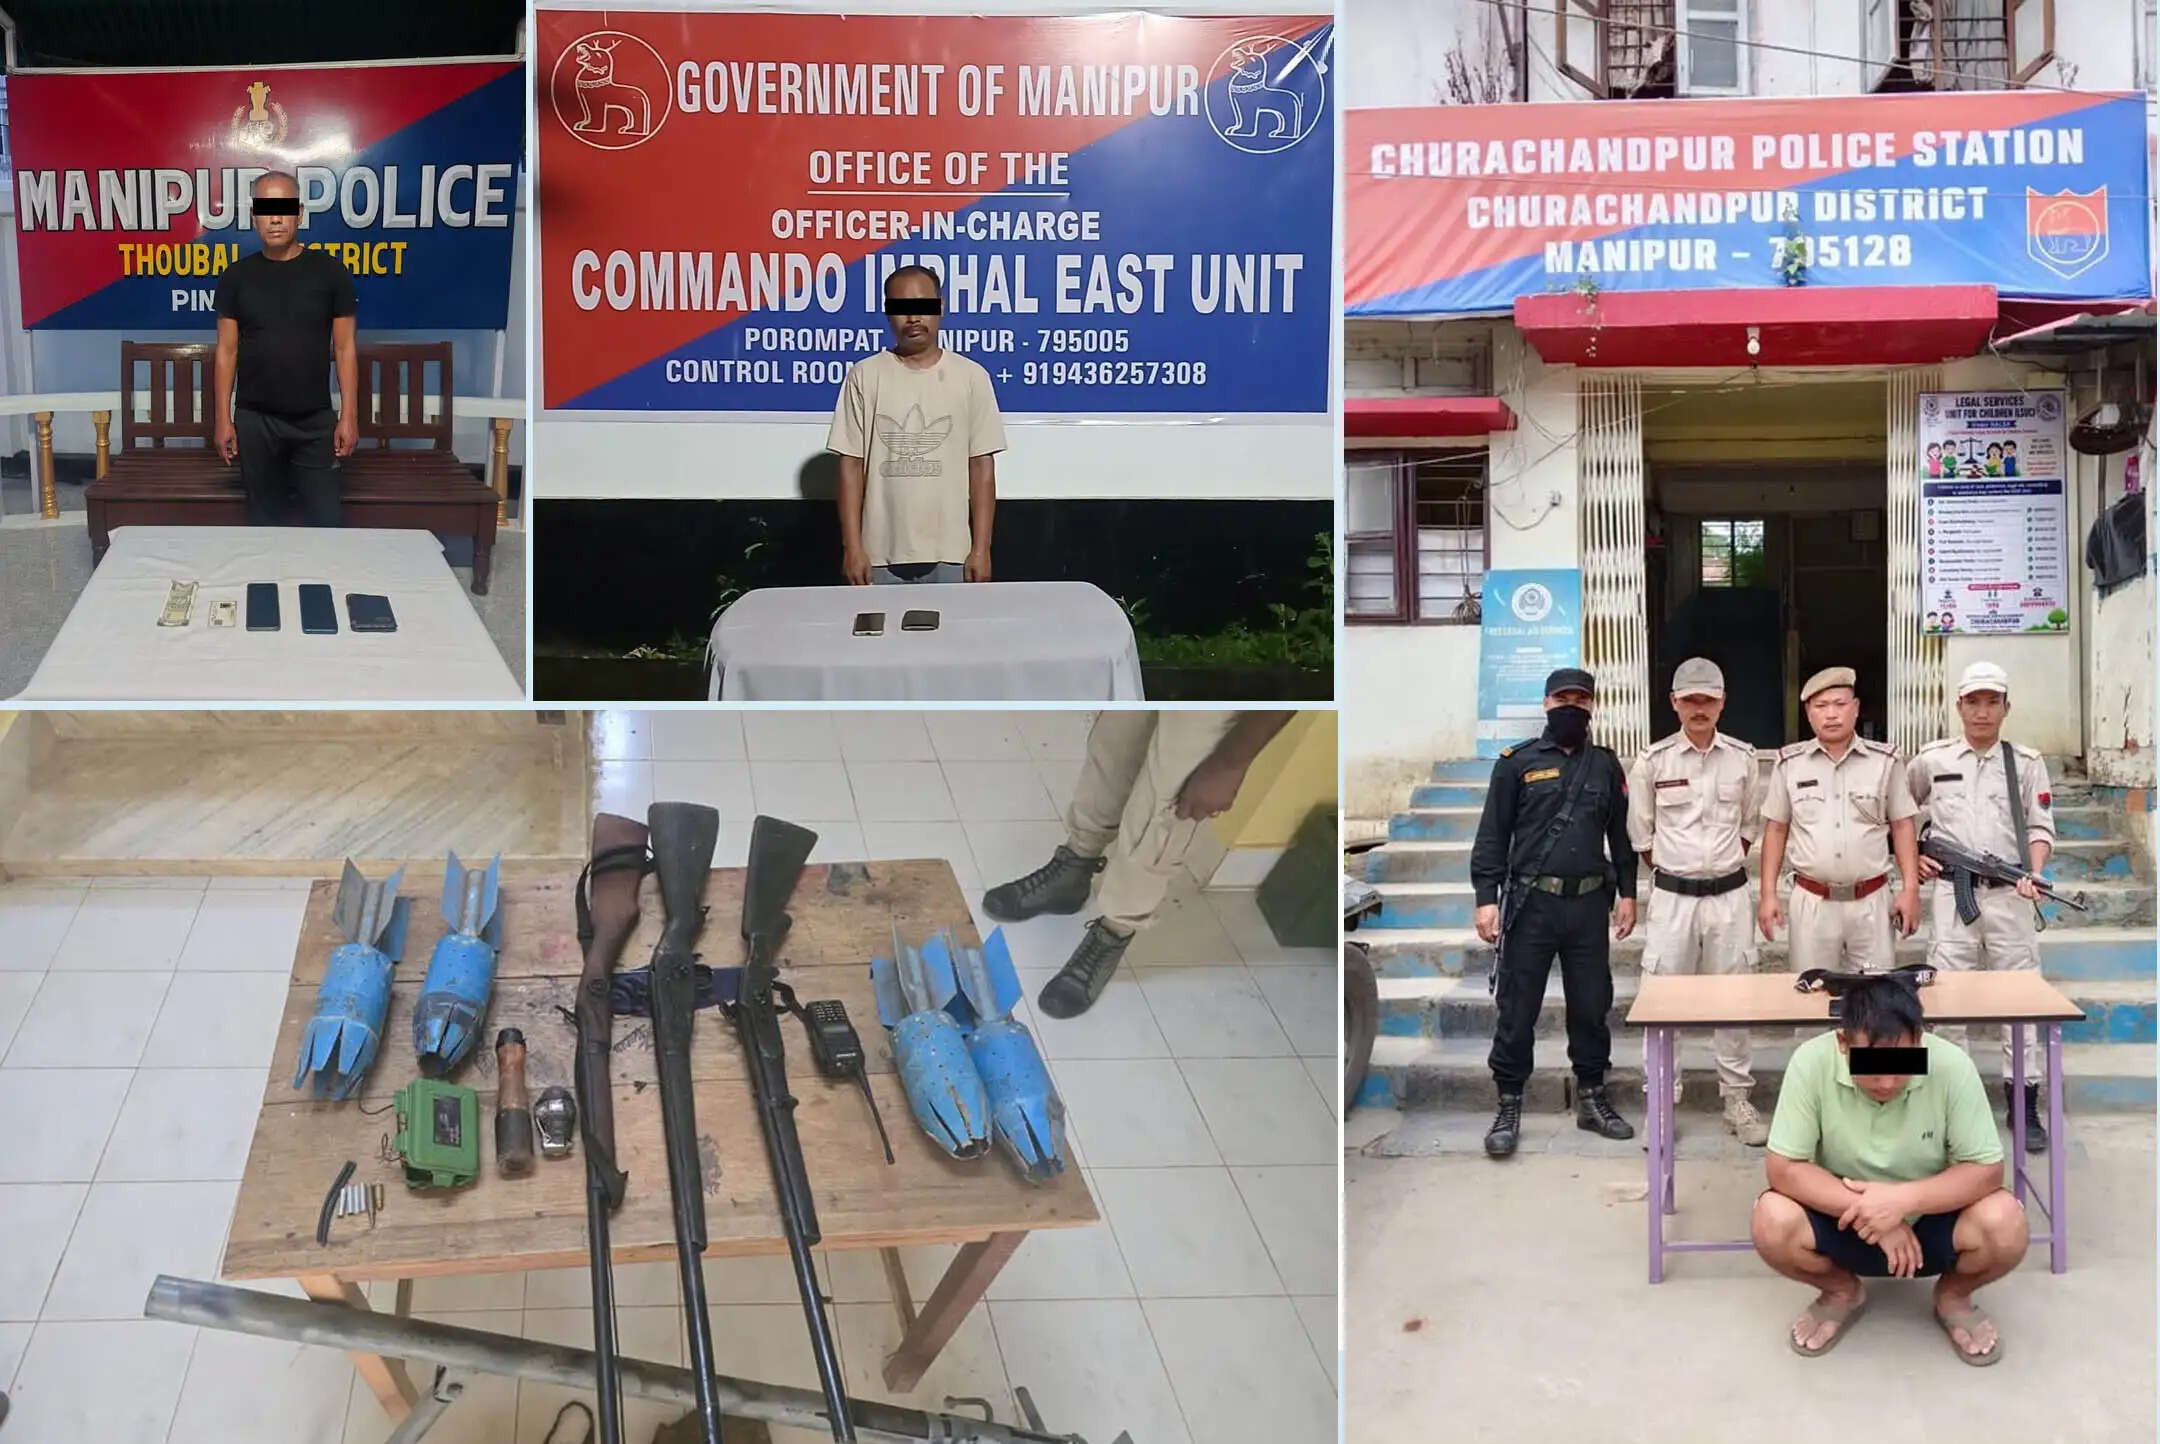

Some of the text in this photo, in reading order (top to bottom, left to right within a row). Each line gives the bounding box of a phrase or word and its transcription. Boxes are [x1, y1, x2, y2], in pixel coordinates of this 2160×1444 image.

[677, 61, 1200, 117] GOVERNMENT OF MANIPUR
[809, 151, 1069, 186] OFFICE OF THE
[1371, 127, 2084, 178] CHURACHANDPUR POLICE STATION
[296, 163, 513, 230] POLICE
[1467, 185, 1988, 228] CHURACHANDPUR DISTRICT
[772, 209, 1101, 243] OFFICER-IN-CHARGE
[1544, 238, 1717, 274] MANIPUR
[571, 250, 847, 313] COMMANDO
[1055, 253, 1175, 314] EAST
[1191, 254, 1304, 314] UNIT
[938, 329, 1015, 353] NIPUR
[1037, 329, 1129, 354] 795005
[666, 359, 784, 385] CONTROL
[792, 360, 853, 385] ROO
[1022, 361, 1208, 387] 919436257308
